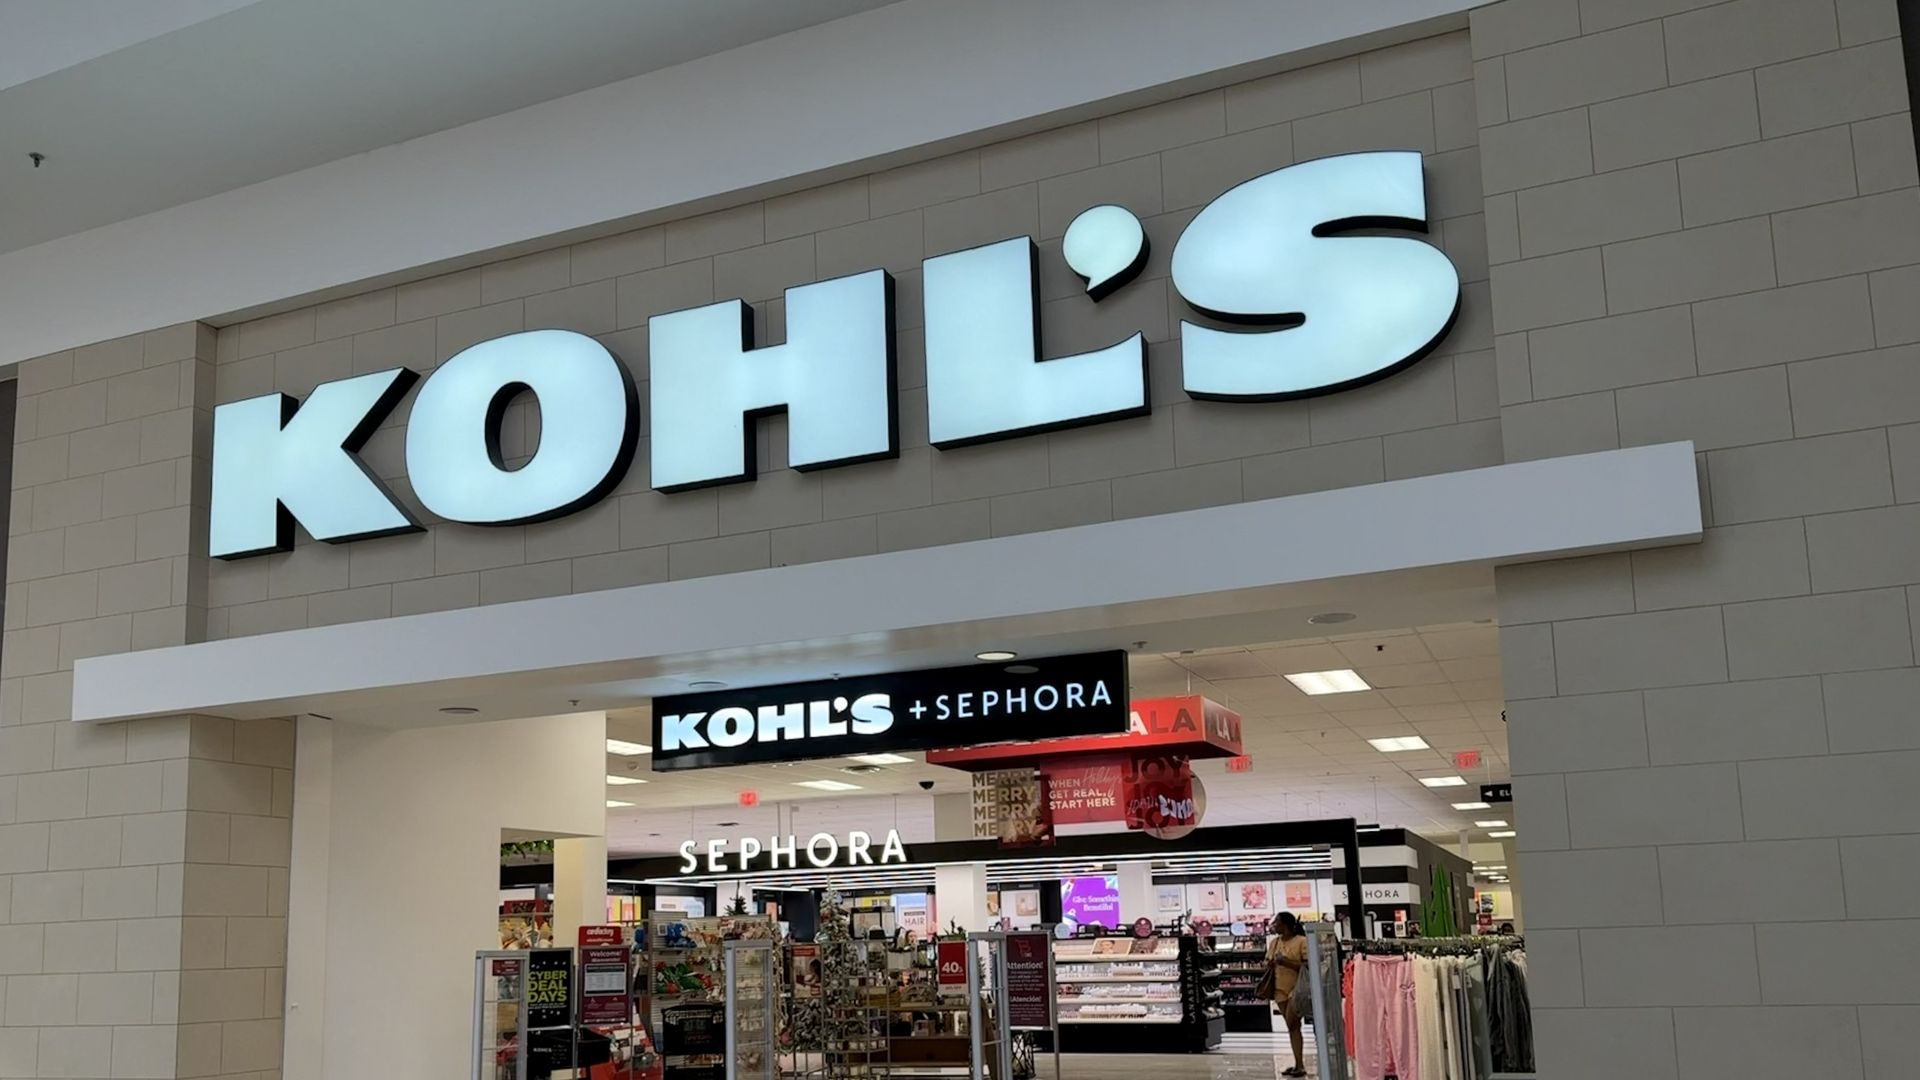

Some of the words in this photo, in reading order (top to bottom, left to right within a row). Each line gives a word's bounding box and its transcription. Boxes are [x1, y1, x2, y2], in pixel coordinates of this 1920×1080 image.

[209, 150, 1462, 561] KOHL'S
[661, 693, 895, 752] KOHL'S
[972, 770, 1035, 787] MERRY
[1048, 778, 1081, 789] WHEN
[973, 785, 1037, 804] MERRY
[1048, 790, 1069, 799] GET
[974, 802, 1038, 820] MERRY
[1049, 799, 1083, 811] START
[1086, 797, 1116, 808] HERE
[974, 819, 1037, 837] MERY
[679, 829, 908, 874] SEPHORA
[1088, 894, 1119, 903] Somethin
[1341, 889, 1400, 899] SHORA
[904, 917, 926, 926] HAIR
[528, 970, 568, 981] CYBER
[528, 979, 568, 991] DEAL
[1185, 950, 1196, 1024] ANASTASIA
[527, 990, 568, 1003] DAYS
